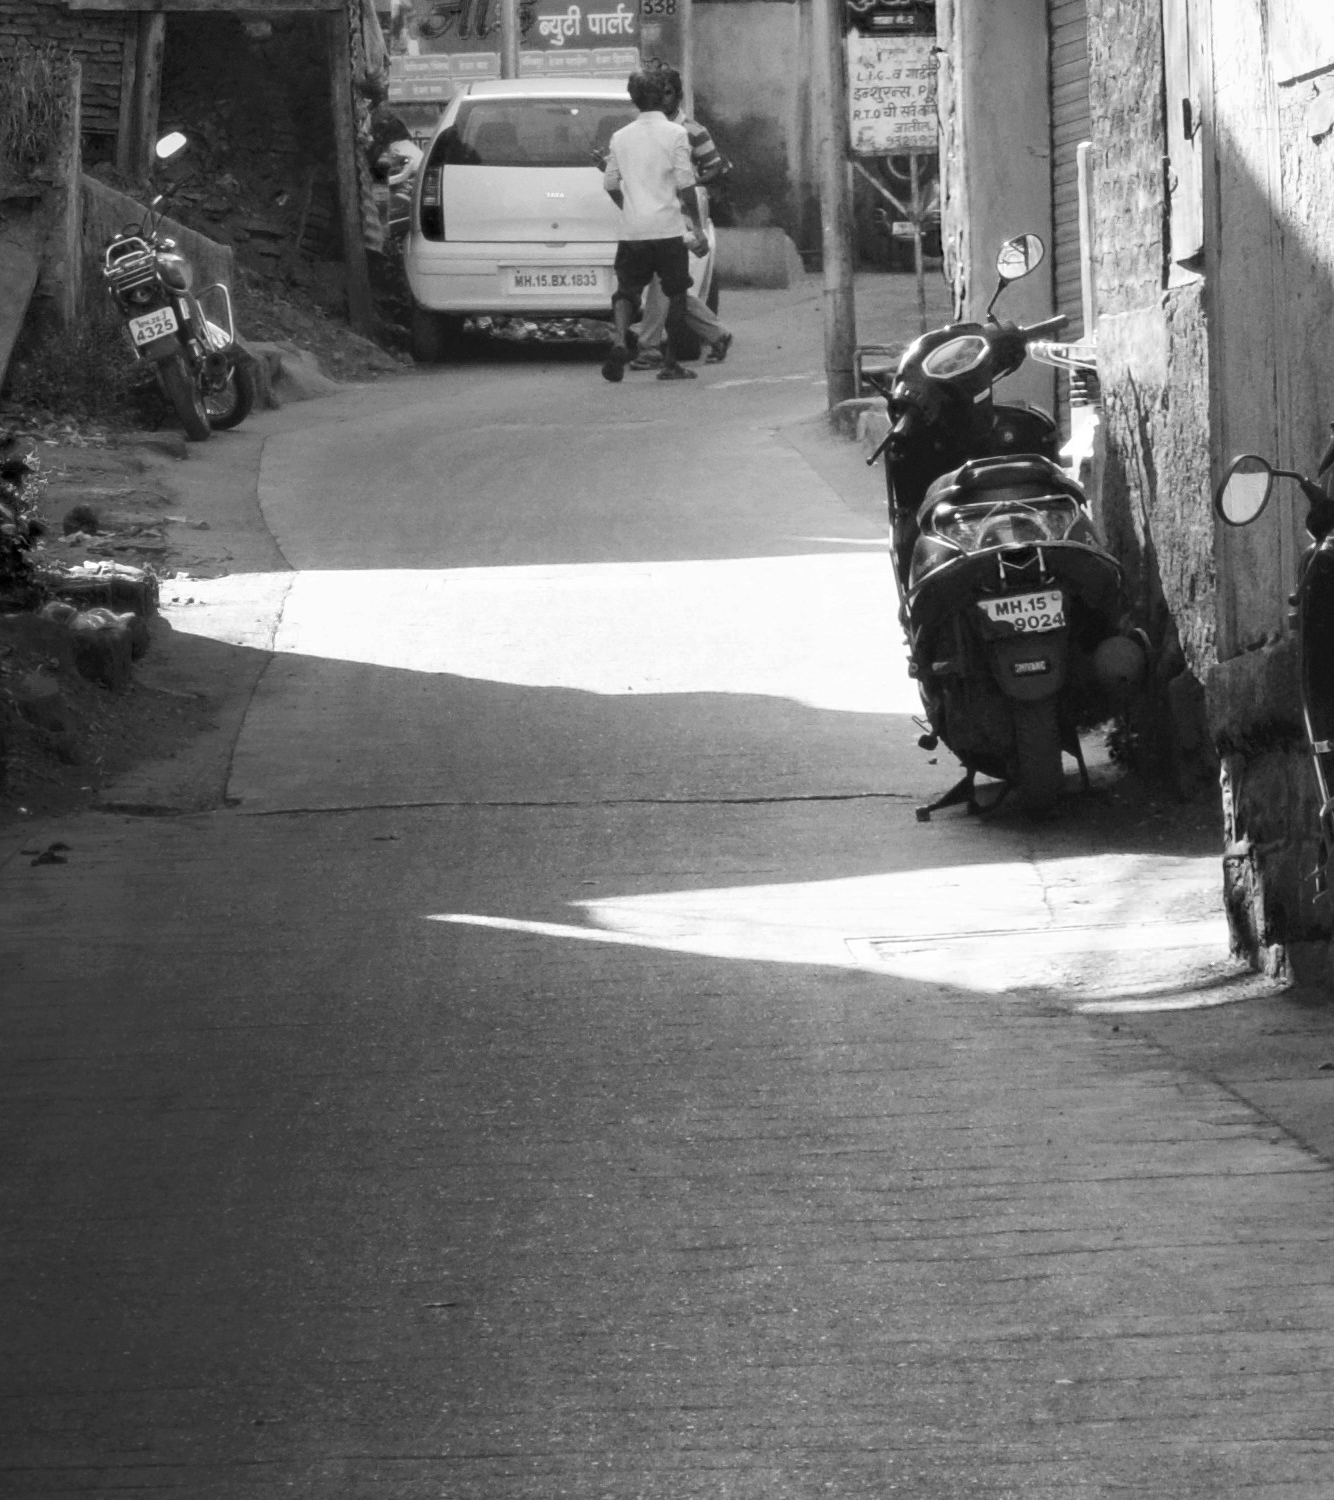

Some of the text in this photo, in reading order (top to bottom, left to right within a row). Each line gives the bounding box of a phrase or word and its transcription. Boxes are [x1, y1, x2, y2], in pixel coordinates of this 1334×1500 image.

[538, 5, 581, 46] ब्युटी
[586, 3, 636, 37] पार्लर
[137, 319, 174, 341] 4325
[994, 597, 1048, 618] MH.15
